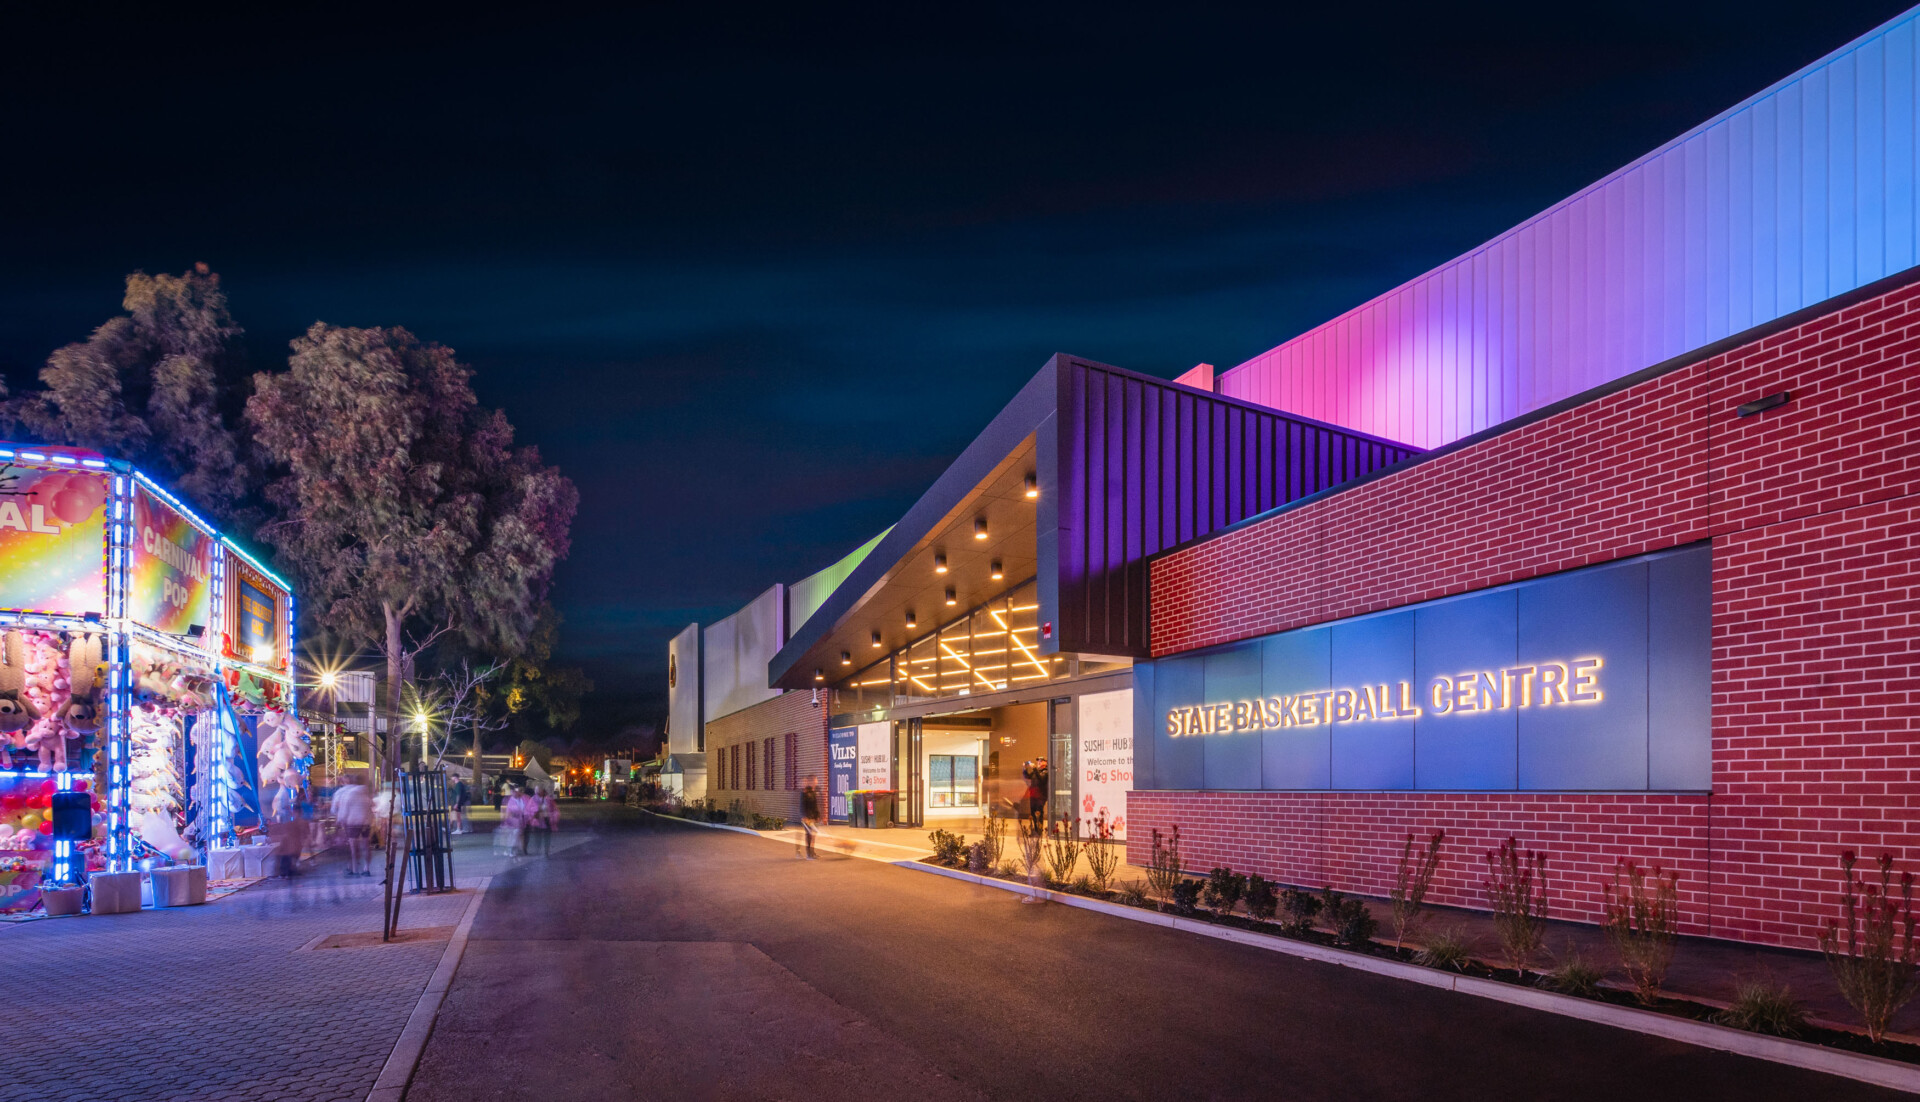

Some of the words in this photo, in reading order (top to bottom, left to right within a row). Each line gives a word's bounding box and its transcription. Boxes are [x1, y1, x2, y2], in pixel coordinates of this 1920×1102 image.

[143, 525, 204, 584] CARNIVAL
[163, 575, 188, 610] POP
[1165, 704, 1231, 736] STATE
[1234, 681, 1420, 731] BASKETBALL
[1431, 657, 1603, 715] CENTRE
[1084, 739, 1104, 752] SUSHI
[1113, 738, 1127, 750] HUB
